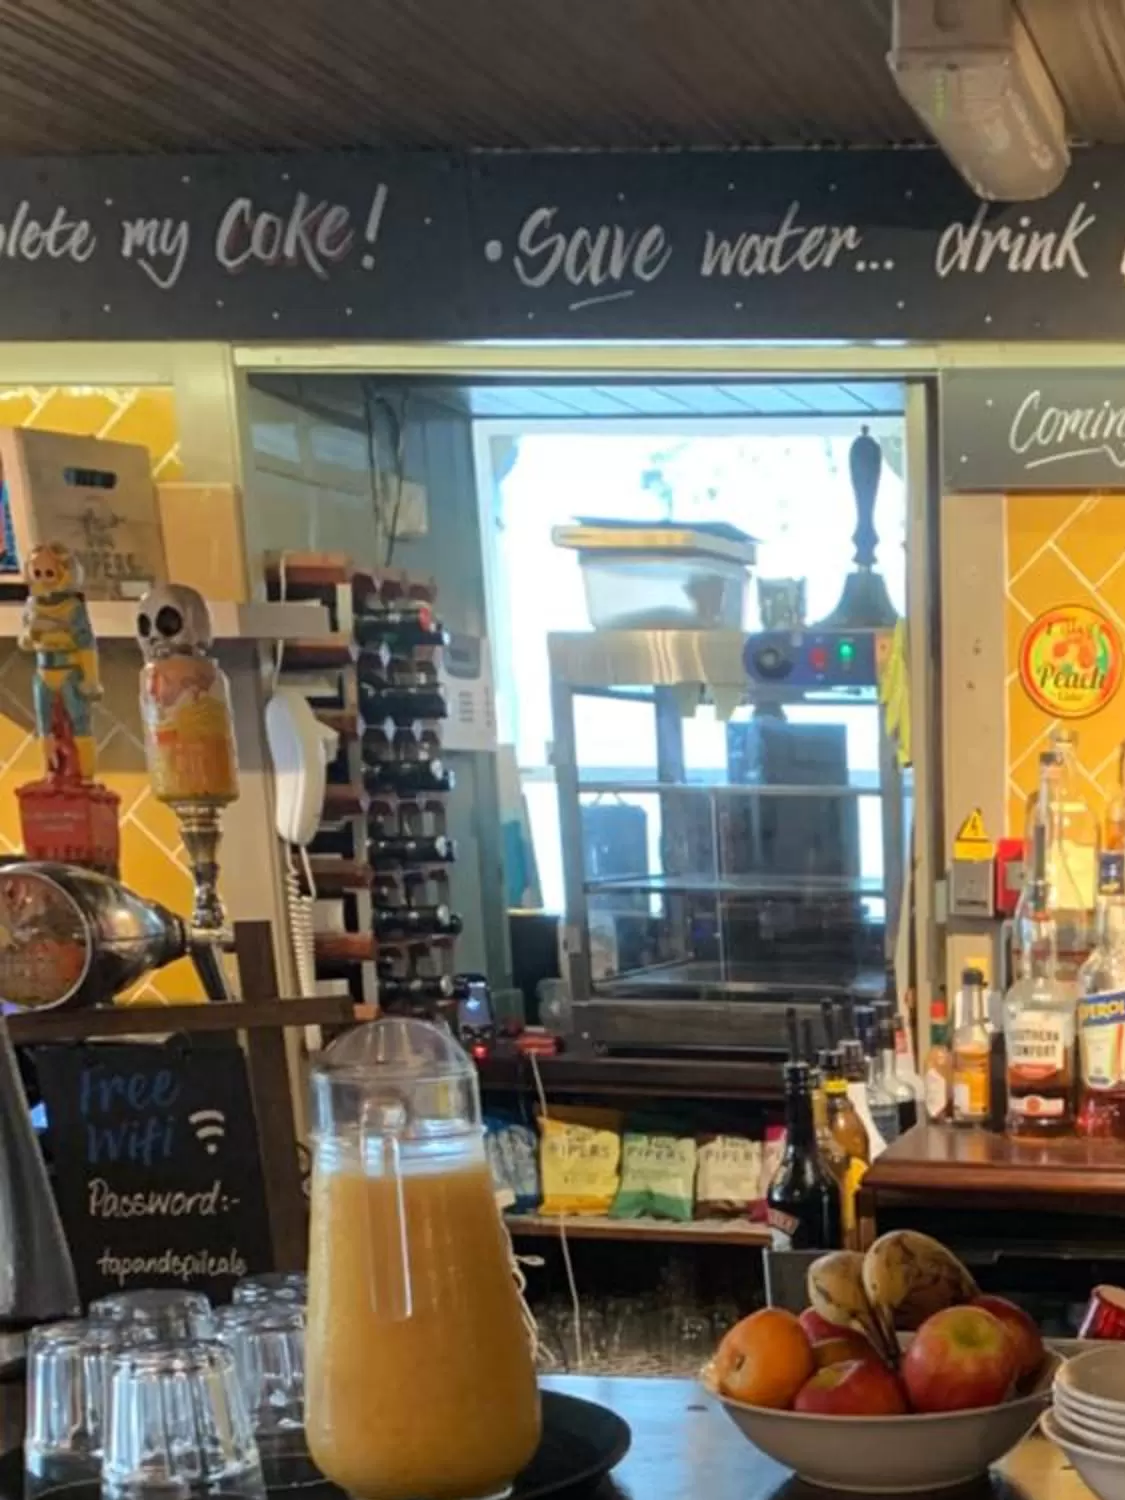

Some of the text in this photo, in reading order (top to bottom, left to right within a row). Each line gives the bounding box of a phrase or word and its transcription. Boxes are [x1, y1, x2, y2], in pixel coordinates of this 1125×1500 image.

[0, 184, 388, 288] lete my Coke!
[514, 207, 672, 288] Save
[701, 202, 894, 277] water...
[936, 203, 1096, 279] drink
[79, 1066, 180, 1116] Free
